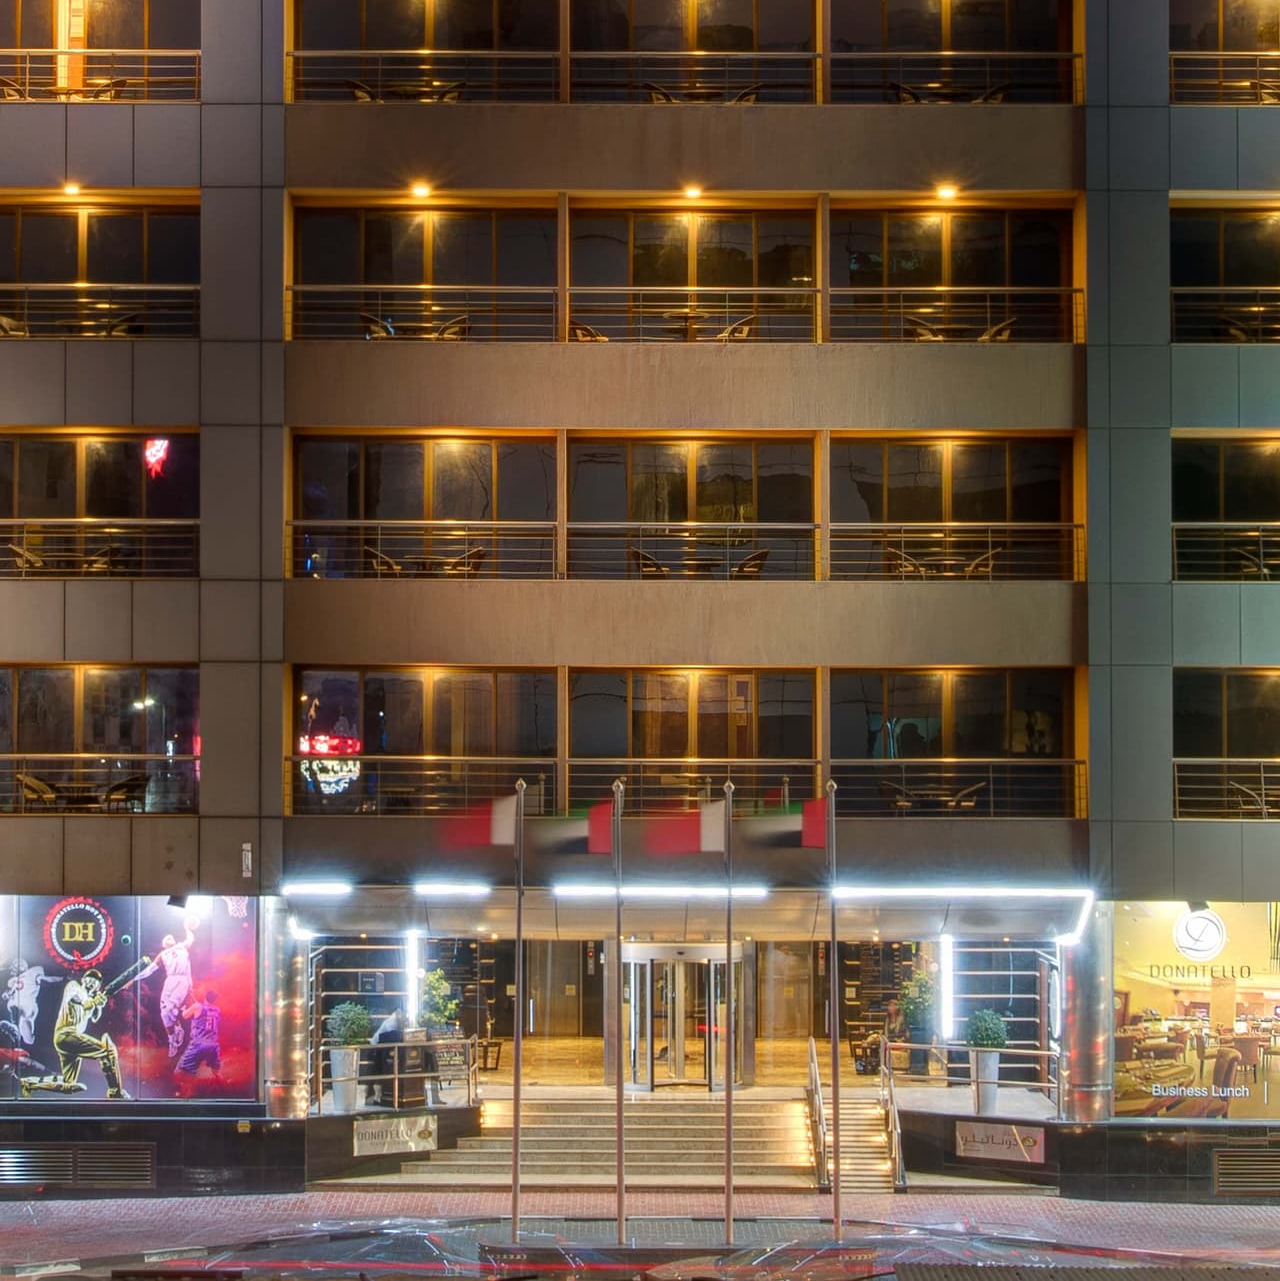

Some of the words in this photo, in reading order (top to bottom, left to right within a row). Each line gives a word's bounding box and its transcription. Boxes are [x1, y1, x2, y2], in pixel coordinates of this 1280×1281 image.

[62, 921, 95, 942] DH
[1149, 965, 1251, 979] DONATELLO
[1151, 1084, 1209, 1097] Business
[1211, 1084, 1250, 1097] Lunch
